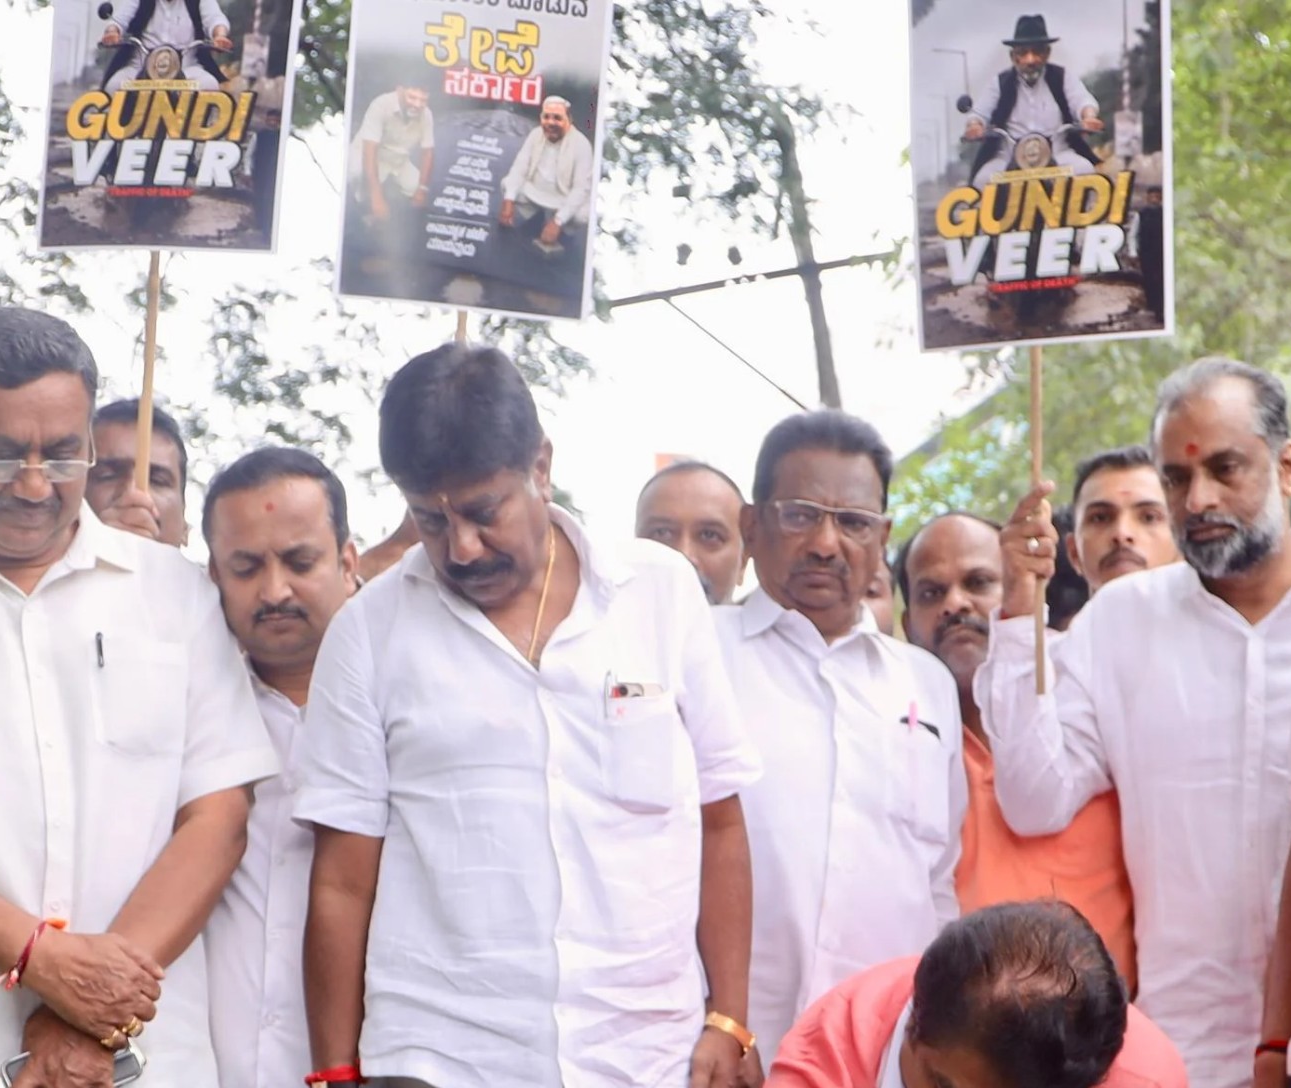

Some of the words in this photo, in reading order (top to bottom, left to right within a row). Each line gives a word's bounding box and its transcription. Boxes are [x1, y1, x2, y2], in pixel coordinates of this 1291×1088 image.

[424, 12, 539, 76] ತೇಪೆ
[66, 90, 255, 141] GUNDI
[444, 69, 542, 106] ಸರ್ಕಾರ
[71, 139, 241, 188] VEER
[936, 171, 1132, 239] GUNDI
[944, 223, 1125, 286] VEER
